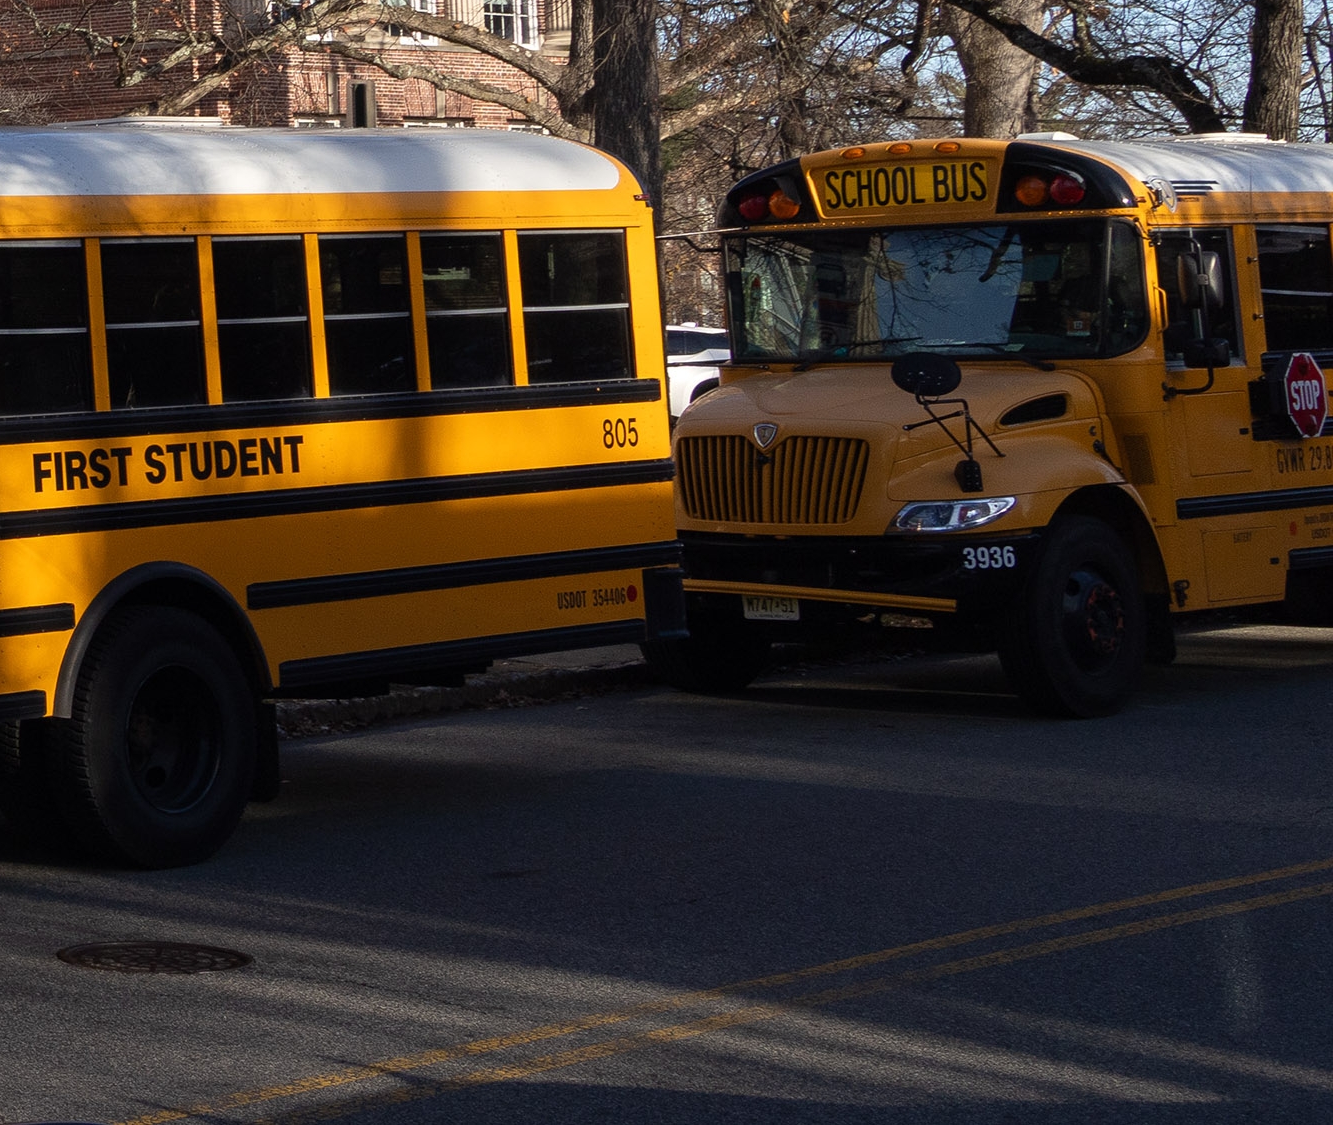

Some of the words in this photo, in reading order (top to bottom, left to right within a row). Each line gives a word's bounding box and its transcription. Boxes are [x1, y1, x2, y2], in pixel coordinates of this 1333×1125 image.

[825, 166, 926, 210] SCHOOL
[933, 161, 987, 203] BUS
[1290, 379, 1321, 411] STOP
[602, 417, 639, 449] 805
[33, 446, 133, 493] FIRST
[144, 435, 304, 485] STUDENT
[1277, 447, 1306, 474] GVWR
[962, 545, 1016, 570] 3936
[556, 590, 587, 610] USDOT
[592, 587, 627, 607] 354406
